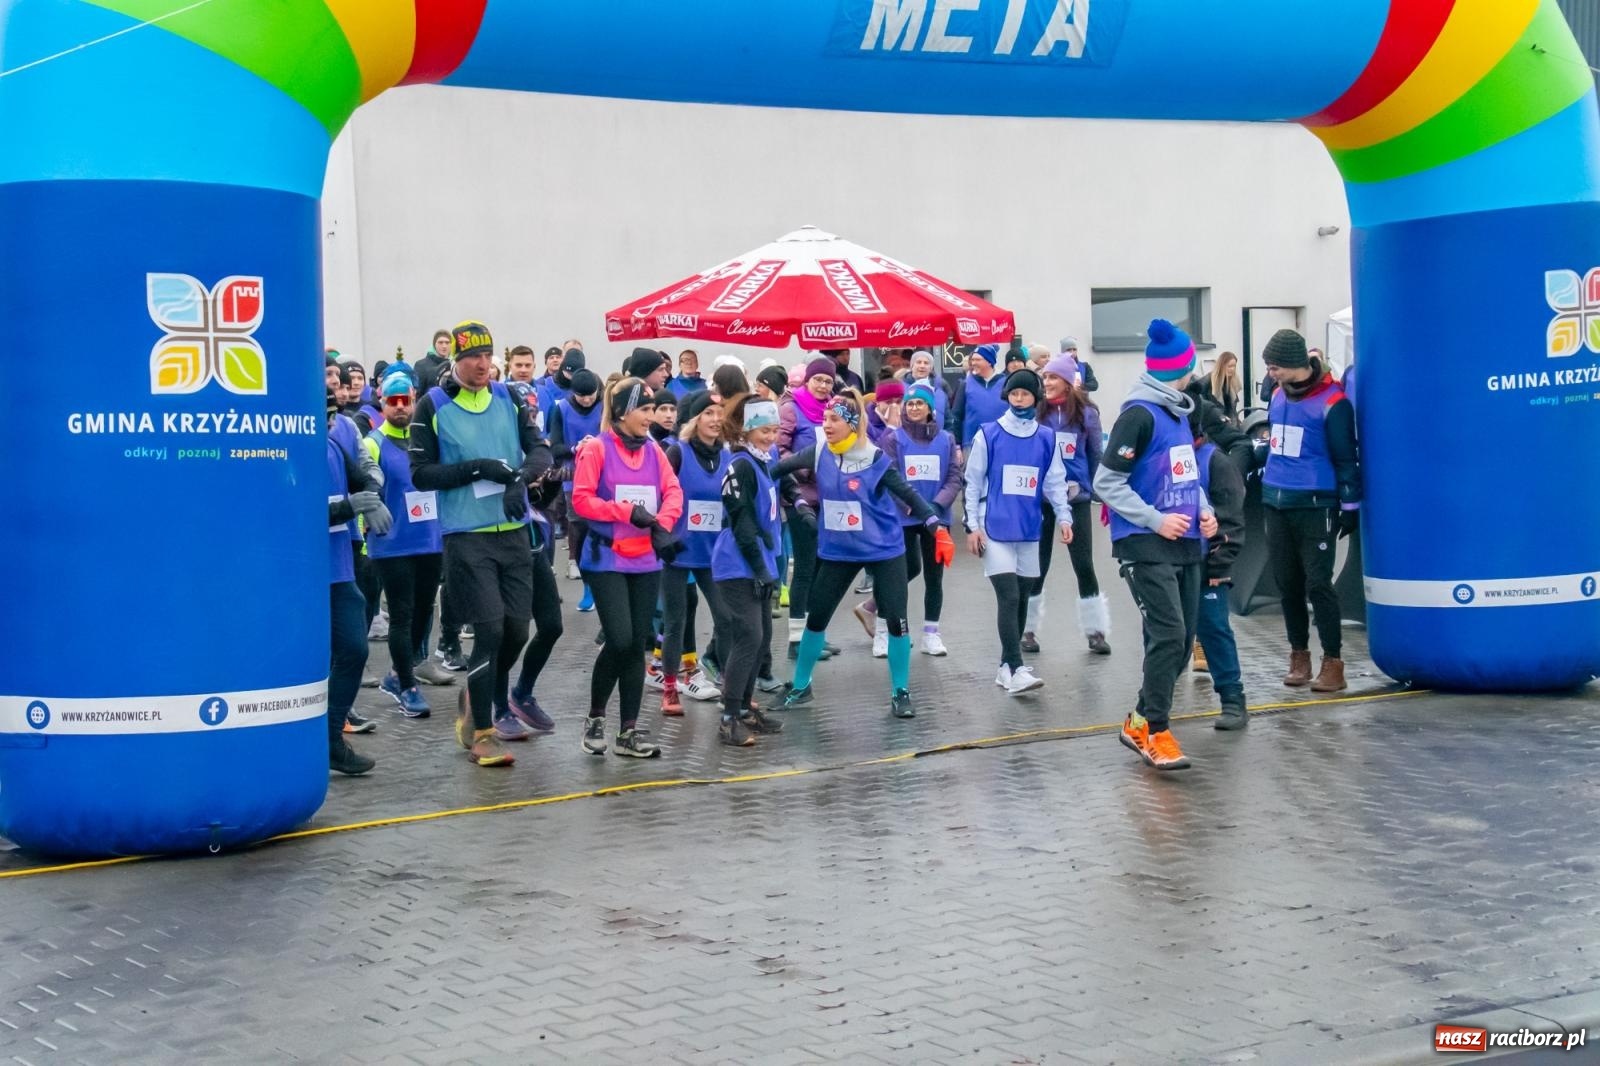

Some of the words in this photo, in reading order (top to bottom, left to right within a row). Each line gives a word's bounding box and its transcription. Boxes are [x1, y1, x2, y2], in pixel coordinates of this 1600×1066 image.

[717, 262, 782, 309] WARKA
[825, 261, 874, 311] WARKA
[727, 318, 771, 335] Classic
[806, 325, 853, 337] WARKA
[888, 320, 932, 339] Classic
[1487, 371, 1551, 391] GMINA
[1555, 363, 1600, 386] KRZYŻ
[67, 412, 155, 434] GMINA
[163, 408, 316, 435] KRZYŻANOWICE
[124, 446, 168, 460] odkryj
[177, 447, 221, 460] poznaj
[229, 447, 288, 461] zapamiętaj
[916, 464, 930, 475] 32
[1015, 475, 1029, 488] 31
[423, 502, 430, 514] 6
[701, 512, 715, 526] 72
[837, 511, 845, 524] 7
[61, 710, 163, 722] WWW.KRZYŻANOWICE.PL
